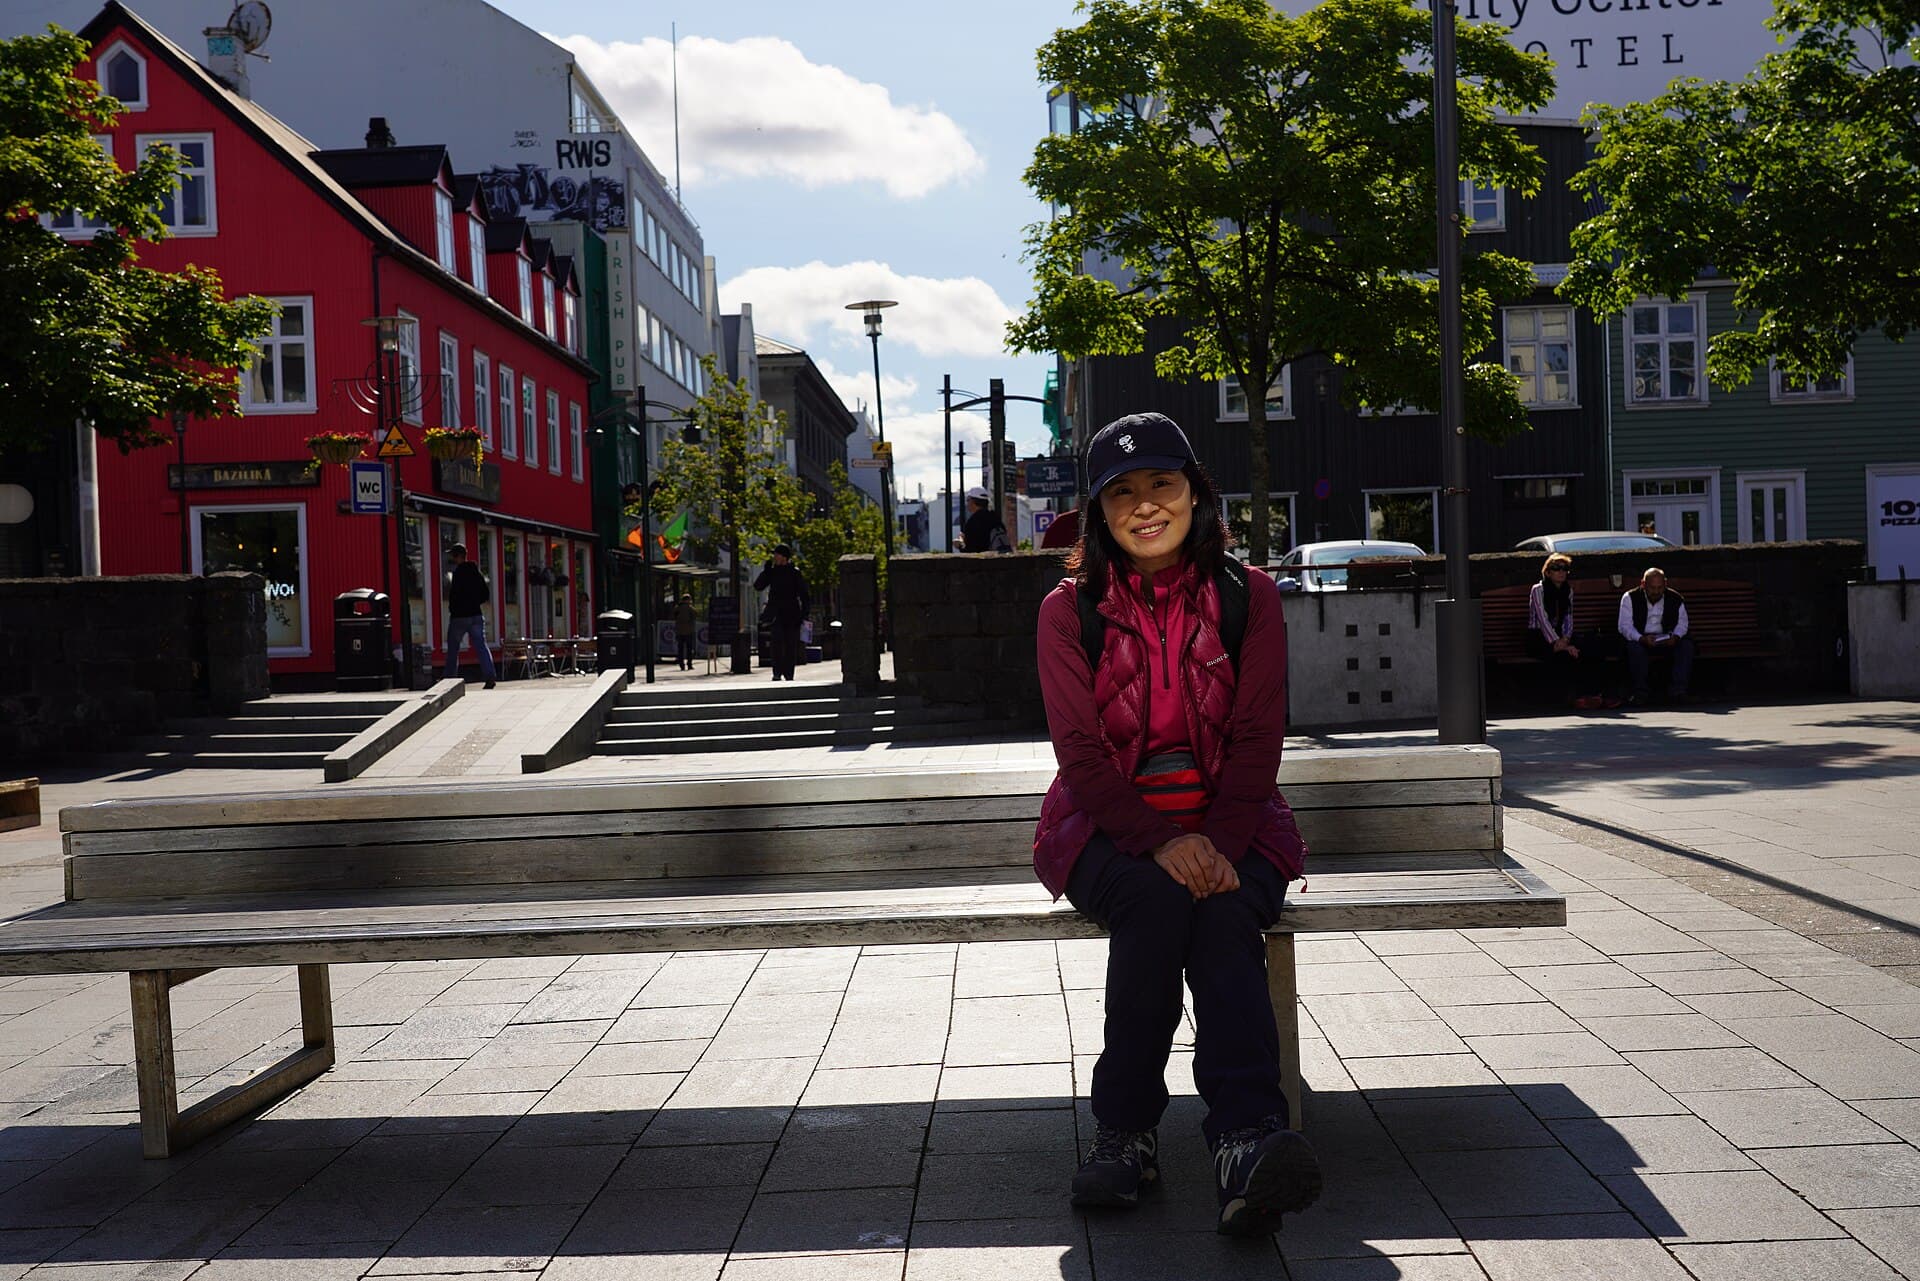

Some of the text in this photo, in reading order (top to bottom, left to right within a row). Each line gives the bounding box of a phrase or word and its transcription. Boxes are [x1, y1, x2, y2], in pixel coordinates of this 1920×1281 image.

[1428, 0, 1528, 28] ity
[1524, 34, 1684, 68] OTEL
[556, 139, 611, 169] RWS
[613, 240, 625, 385] IRISH PUB
[359, 481, 380, 494] WC
[1040, 517, 1049, 529] P
